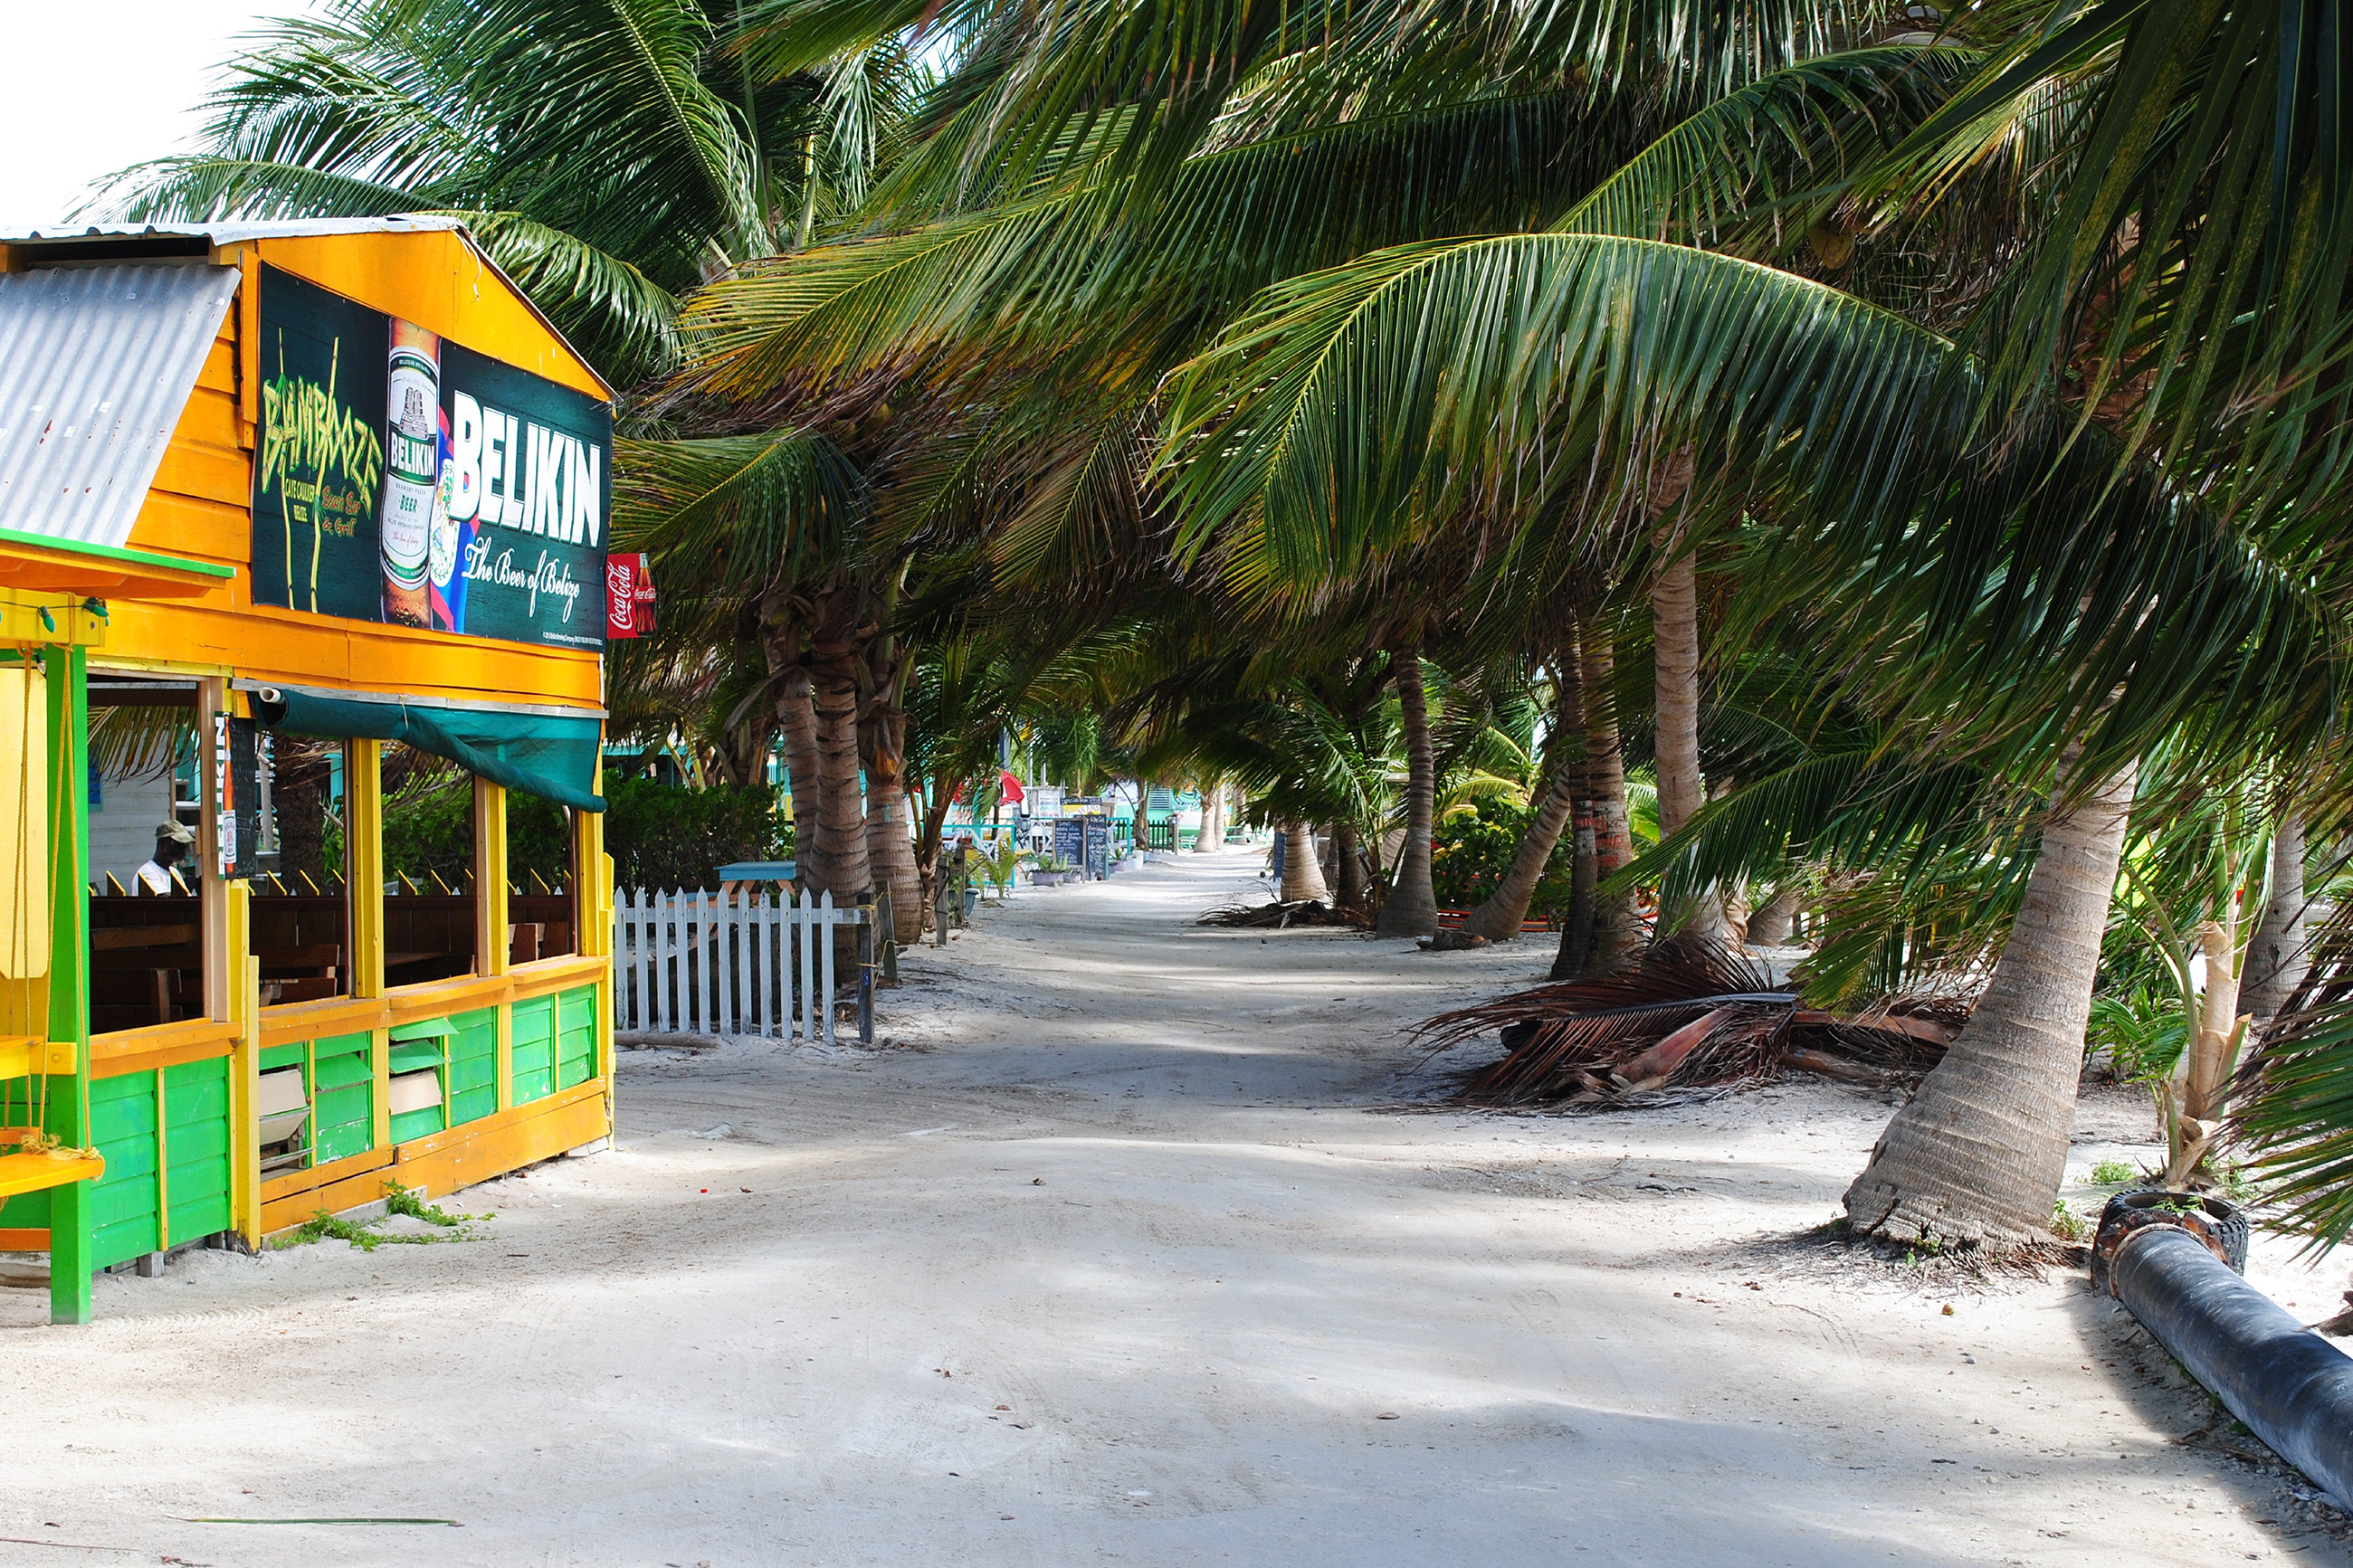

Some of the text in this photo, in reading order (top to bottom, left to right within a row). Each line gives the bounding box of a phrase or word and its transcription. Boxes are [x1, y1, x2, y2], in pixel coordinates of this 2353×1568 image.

[391, 431, 435, 477] BELIKIN
[449, 389, 601, 548] BELIKIN
[345, 491, 361, 516] Bar
[399, 494, 418, 514] BEER
[322, 517, 357, 537] & Grill
[462, 537, 581, 624] The Beer of Belize
